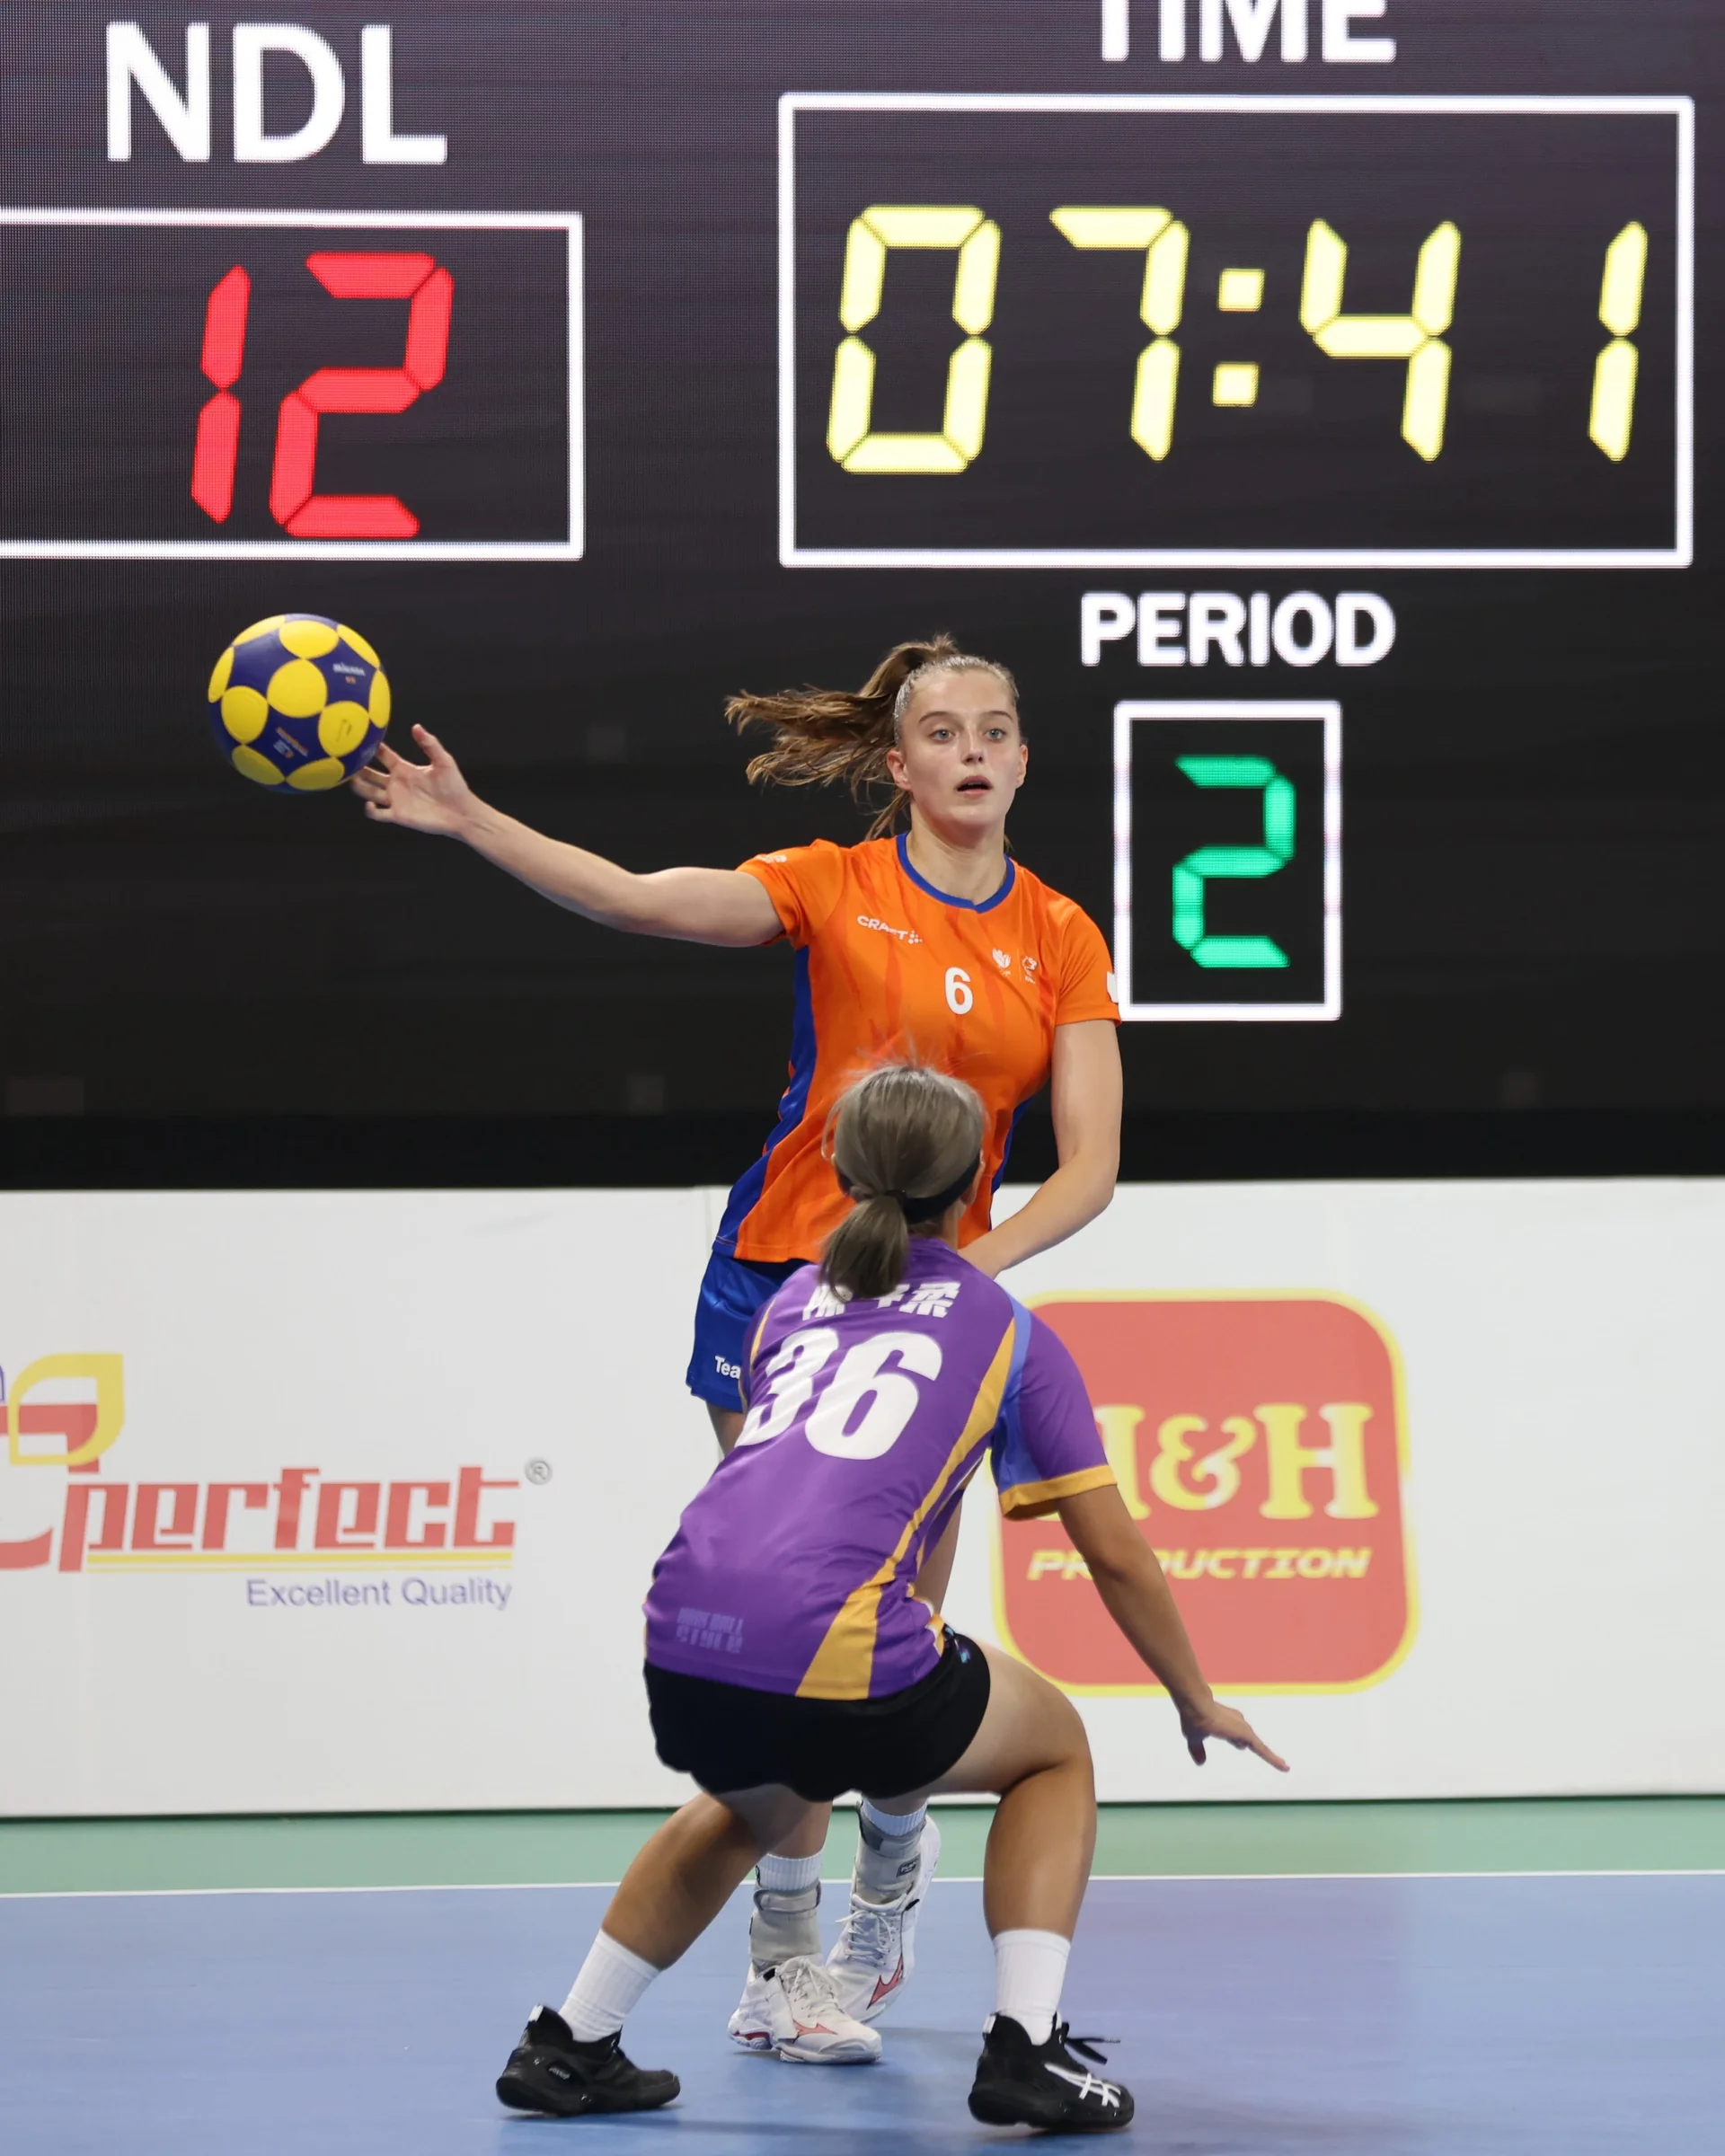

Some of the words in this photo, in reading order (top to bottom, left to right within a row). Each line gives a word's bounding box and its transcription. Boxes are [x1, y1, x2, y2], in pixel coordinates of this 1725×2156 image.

[105, 22, 448, 164] NDL
[826, 205, 1648, 474] 07:41
[190, 251, 455, 538] 12
[1081, 591, 1397, 667] PERIOD
[1172, 755, 1296, 968] 2
[856, 915, 908, 941] CRAFT
[944, 966, 974, 1015] 6
[733, 1327, 943, 1461] 36
[58, 1465, 520, 1573] perfect
[1027, 1547, 1373, 1582] PRUCTION
[246, 1577, 392, 1608] Excellent
[401, 1577, 514, 1612] Quality
